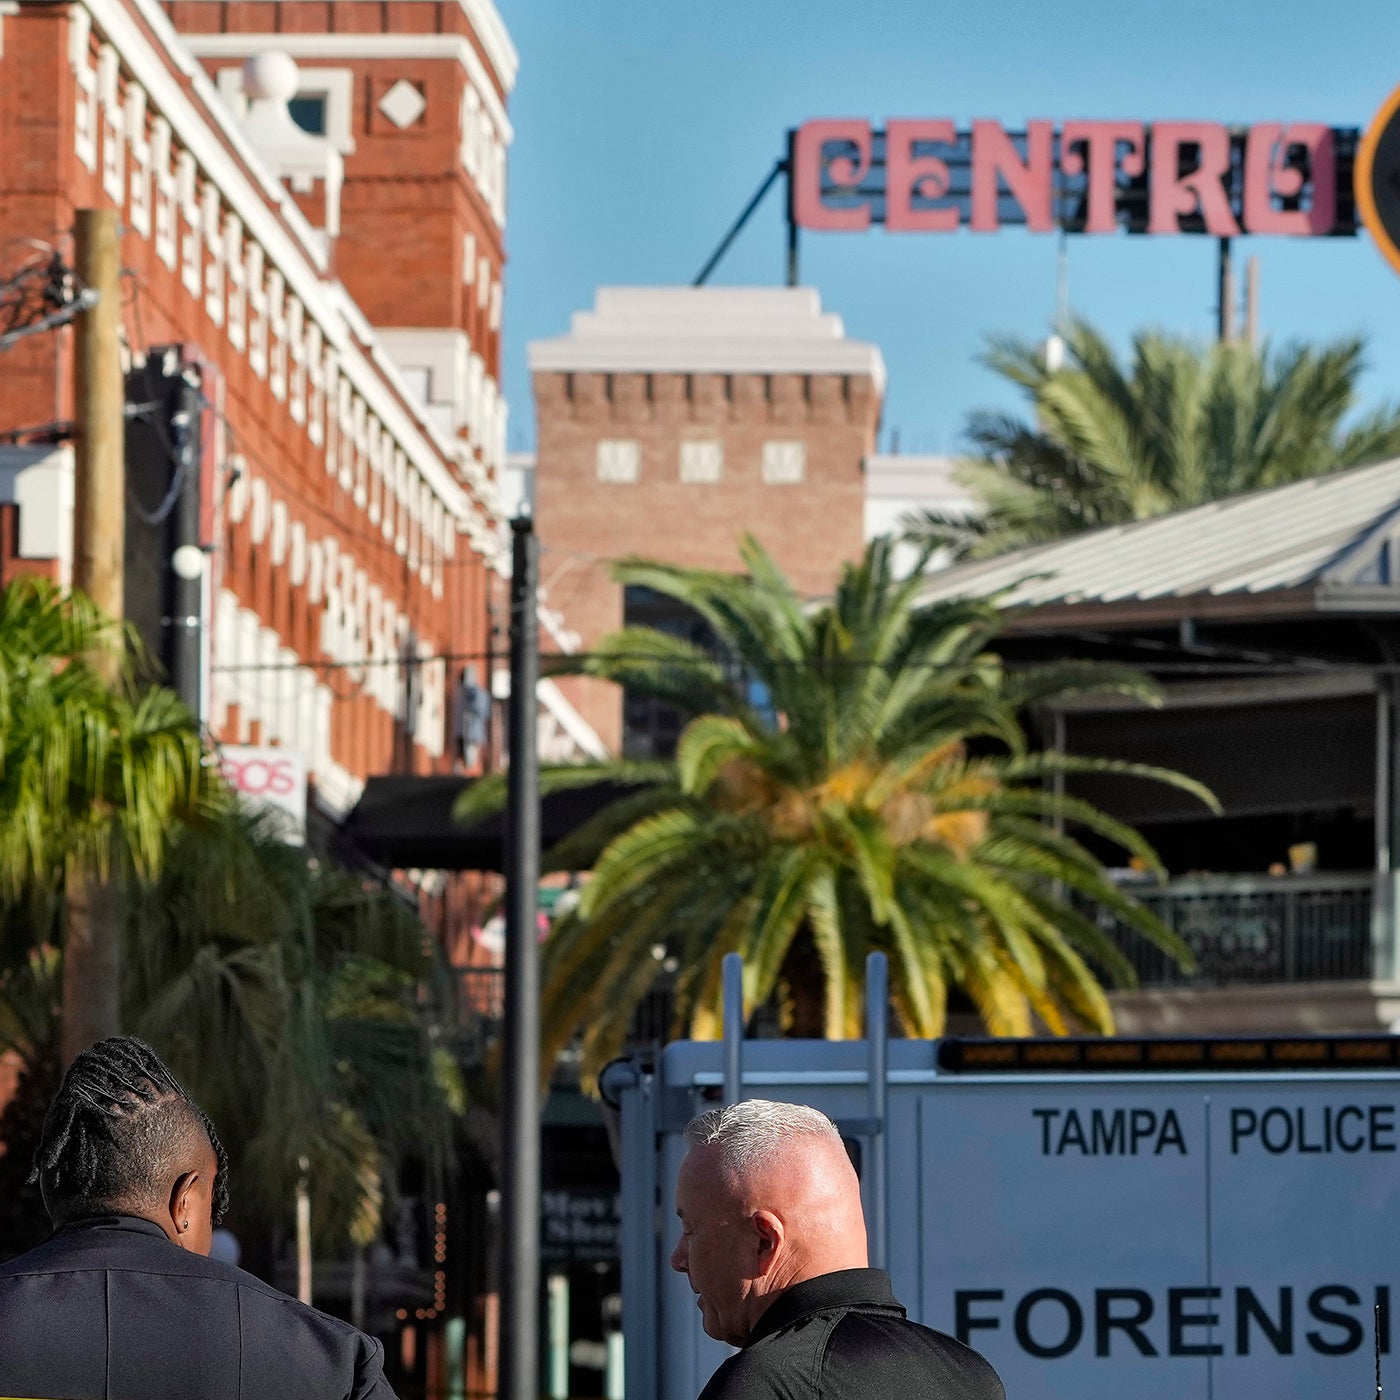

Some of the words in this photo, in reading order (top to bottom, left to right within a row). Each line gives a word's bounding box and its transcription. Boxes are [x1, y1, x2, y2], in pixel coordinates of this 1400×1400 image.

[793, 117, 1337, 237] CENTRO
[1032, 1108, 1188, 1156] TAMPA
[1229, 1105, 1397, 1155] POLICE
